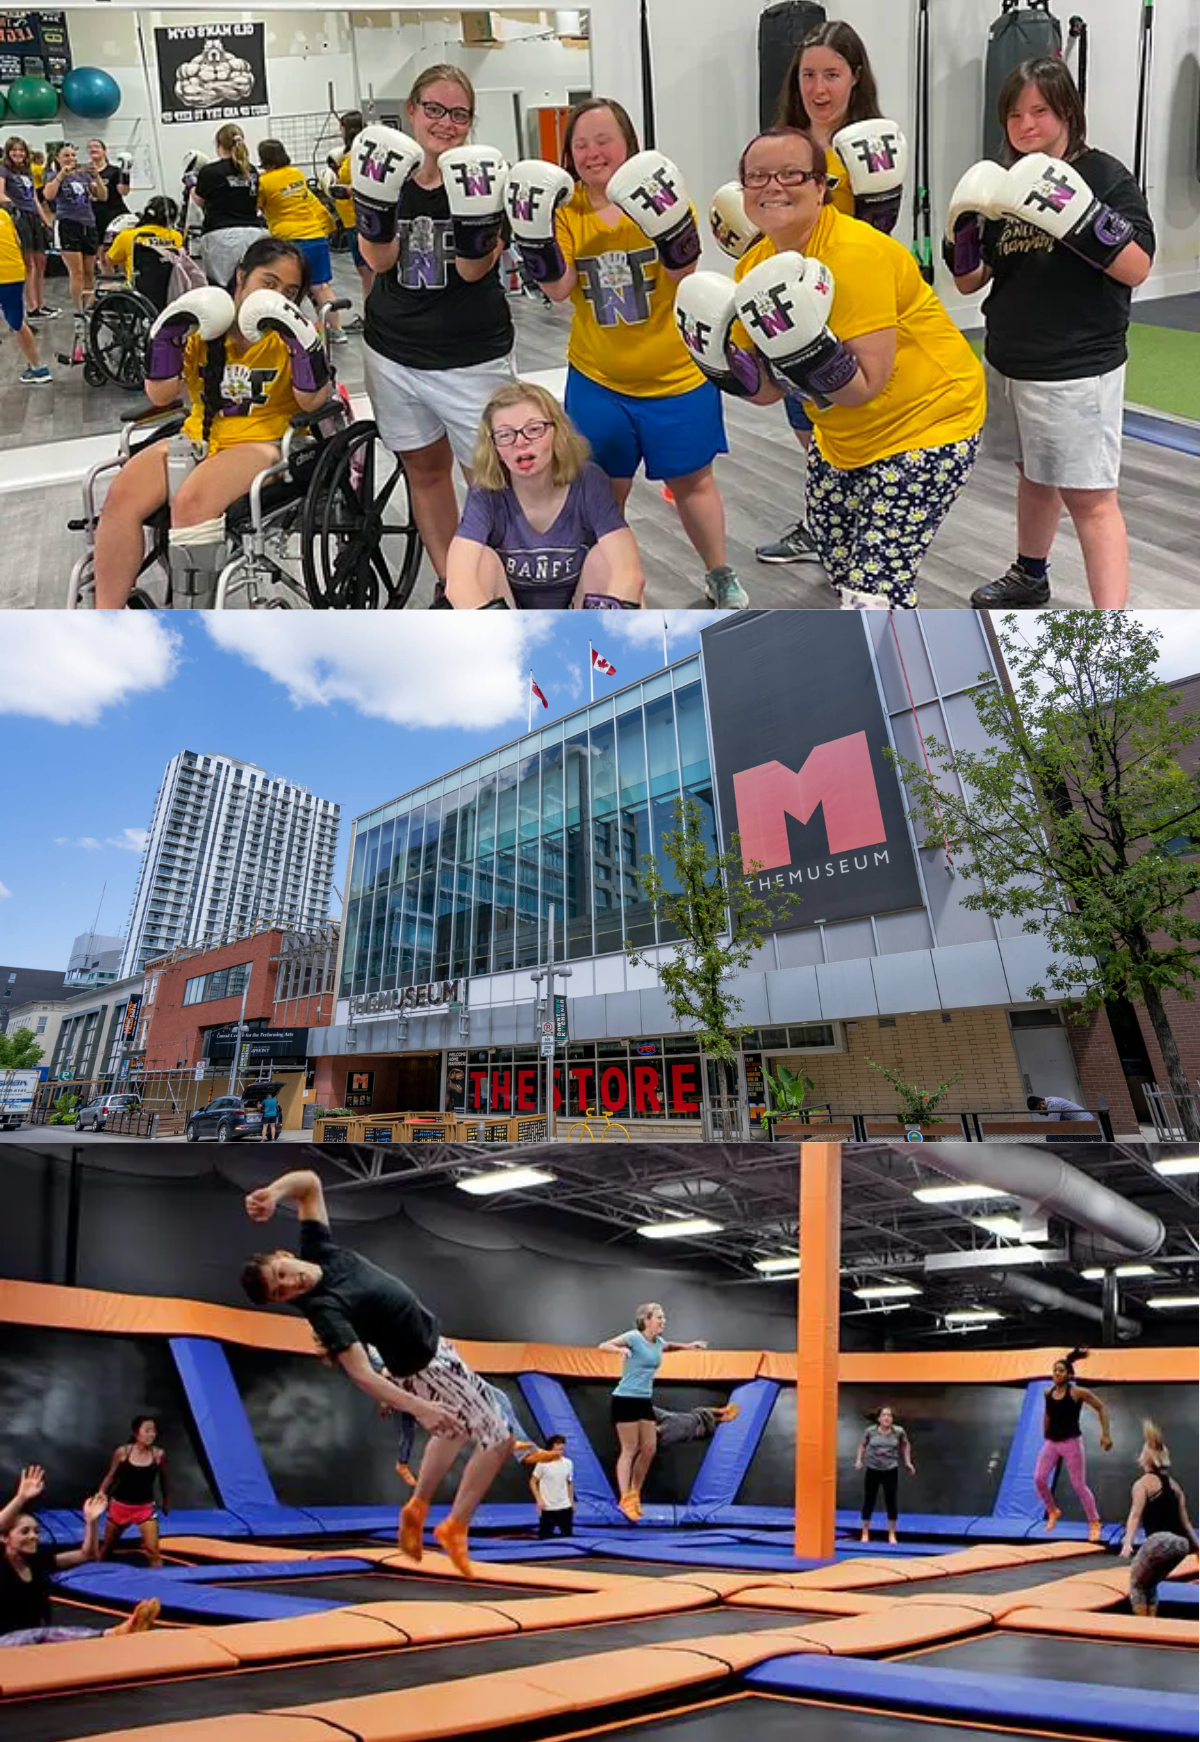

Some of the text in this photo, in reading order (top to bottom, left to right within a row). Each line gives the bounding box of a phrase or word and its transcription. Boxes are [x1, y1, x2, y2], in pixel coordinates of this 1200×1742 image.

[507, 555, 573, 580] BANFF
[744, 849, 890, 894] THEMUSEUM
[637, 1045, 657, 1054] OPEN
[470, 1069, 535, 1111] THE
